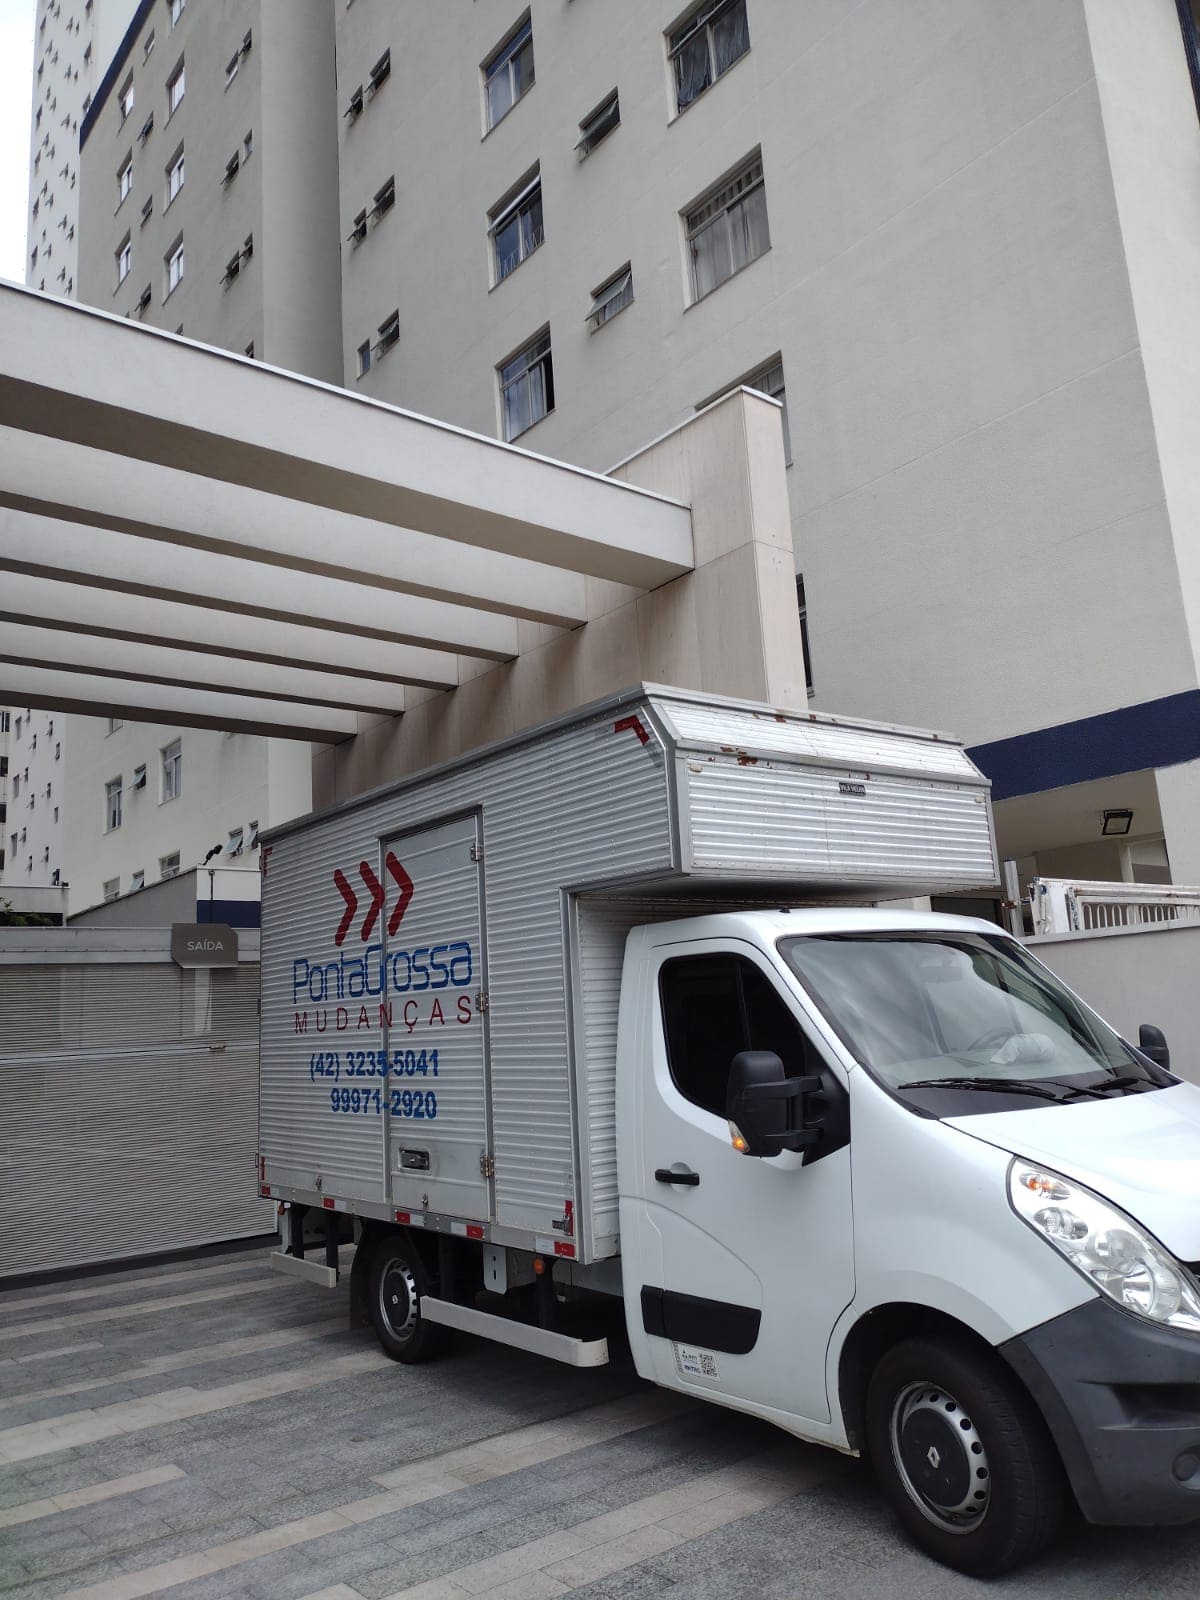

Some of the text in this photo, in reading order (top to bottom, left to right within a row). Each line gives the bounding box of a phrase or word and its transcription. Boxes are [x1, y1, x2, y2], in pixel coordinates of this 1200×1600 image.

[187, 938, 224, 951] SAÍDA
[294, 995, 473, 1034] MUDANÇAS
[310, 1049, 439, 1082] (42) 3235-5041
[330, 1087, 438, 1119] 99971-2920
